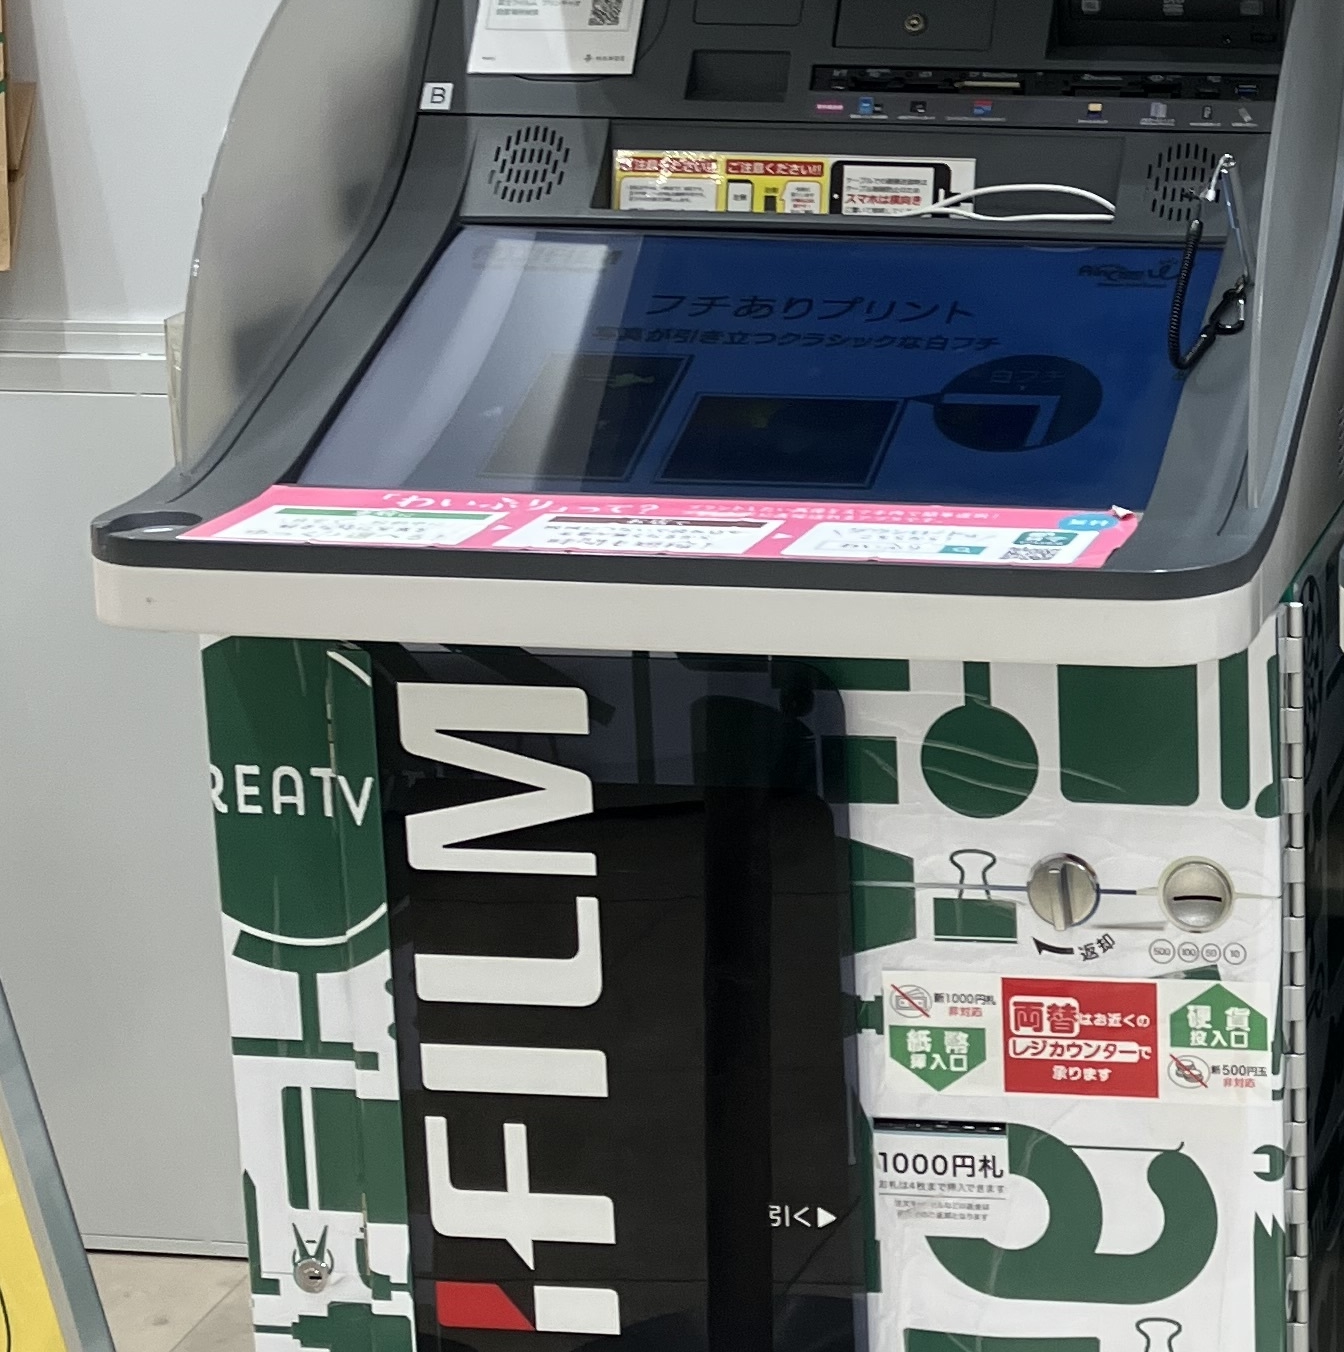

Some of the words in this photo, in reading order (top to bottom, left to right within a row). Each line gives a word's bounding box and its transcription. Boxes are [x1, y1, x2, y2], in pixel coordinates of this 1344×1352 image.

[430, 88, 446, 104] B
[645, 293, 976, 326] フチありプリント
[1078, 933, 1117, 962] 返却
[1152, 947, 1172, 958] 500
[1180, 947, 1197, 958] 100
[933, 992, 997, 1006] 新1000円札
[948, 1006, 983, 1018] 非対応
[1012, 999, 1152, 1035] 両替はお近くの
[1189, 1030, 1249, 1048] 投入口
[1011, 1038, 1152, 1060] レジカウンターで
[1052, 1064, 1112, 1082] 承ります
[1210, 1063, 1268, 1078] 新500円玉
[1222, 1077, 1256, 1089] 非対応
[878, 1151, 1005, 1179] 1000円札
[767, 1205, 812, 1228] 引く
